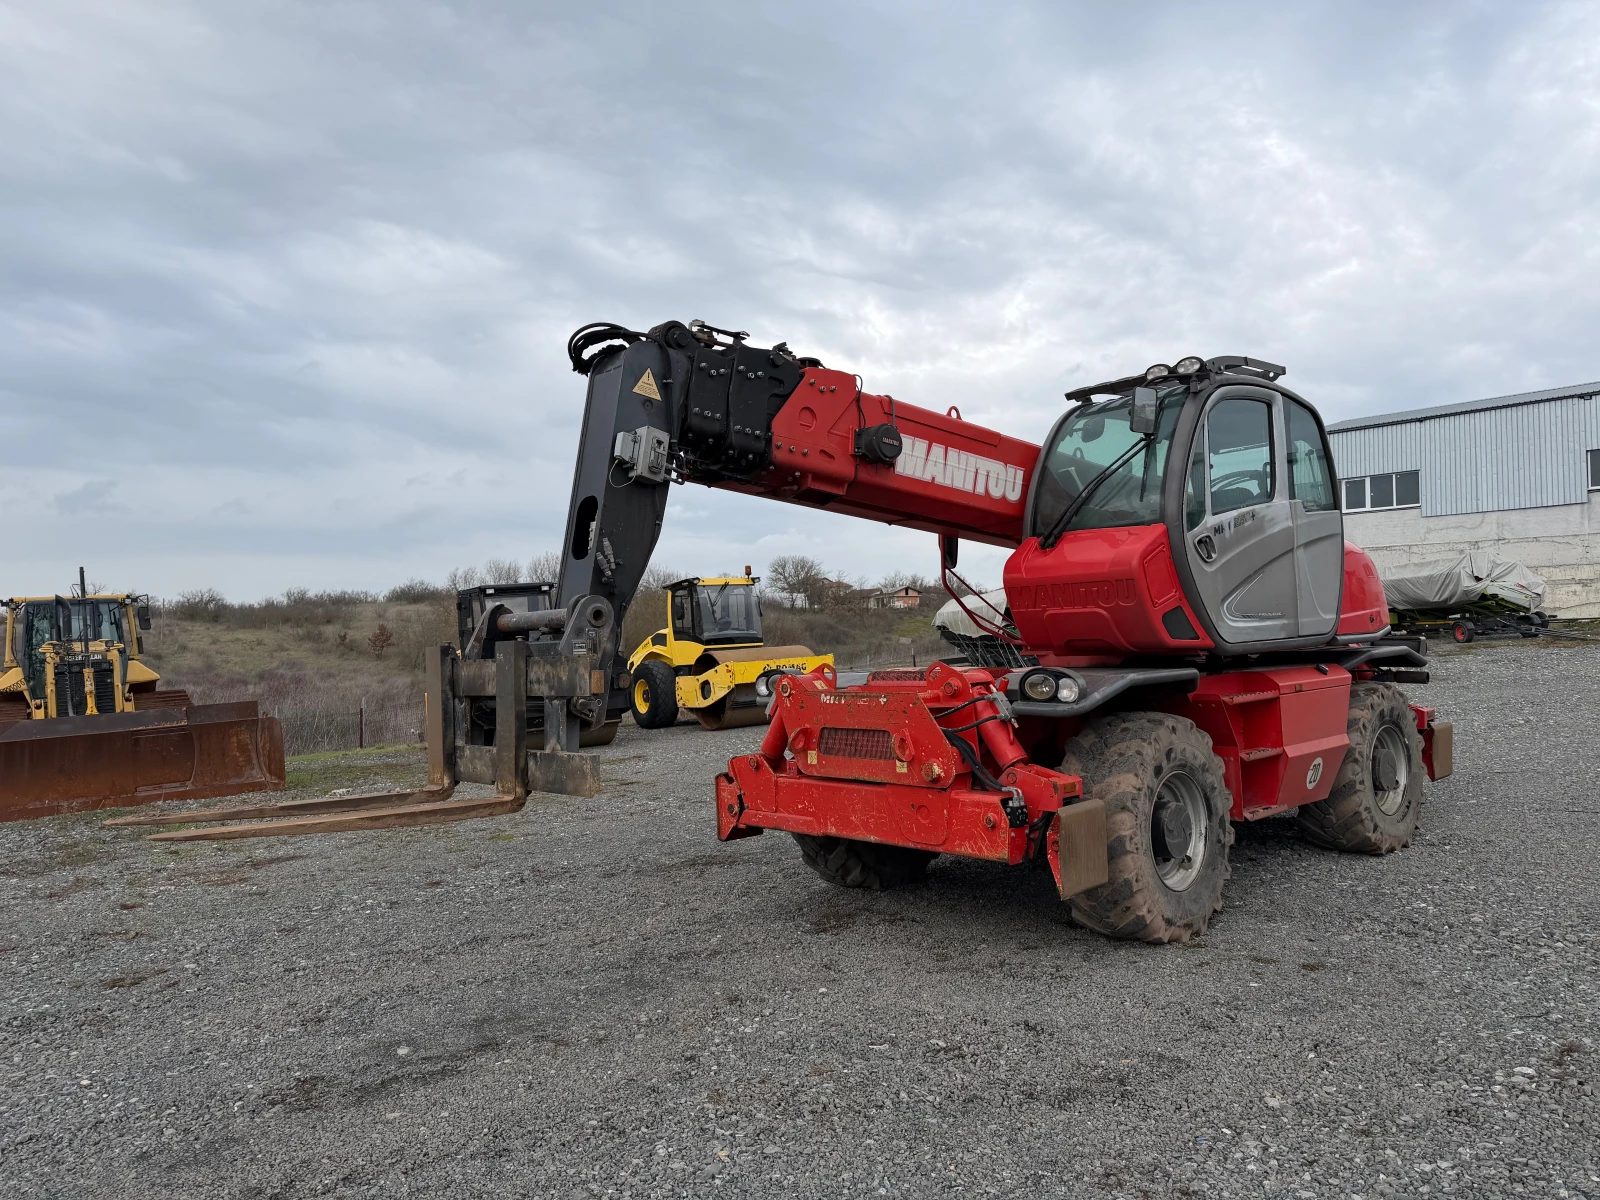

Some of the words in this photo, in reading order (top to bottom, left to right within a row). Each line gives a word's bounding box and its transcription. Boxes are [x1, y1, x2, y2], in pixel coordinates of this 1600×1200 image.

[894, 433, 1025, 503] MANITOU
[1009, 578, 1136, 611] MANITOU
[1308, 763, 1321, 784] 20
